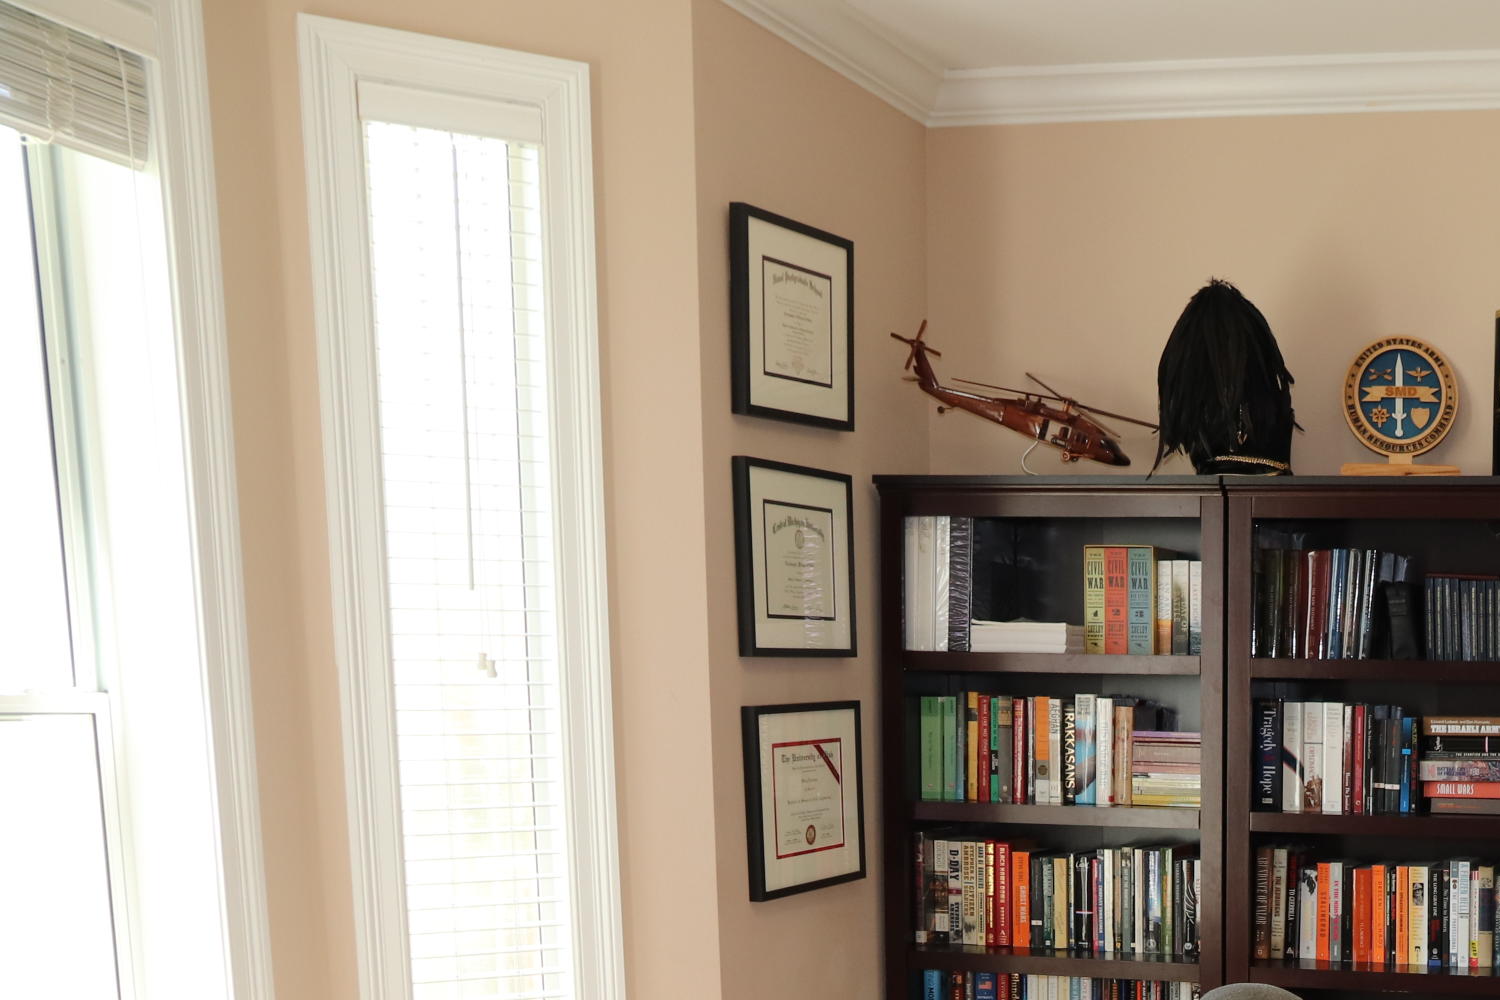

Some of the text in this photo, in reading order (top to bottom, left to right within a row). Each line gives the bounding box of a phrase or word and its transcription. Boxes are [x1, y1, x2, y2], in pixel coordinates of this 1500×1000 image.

[1355, 338, 1444, 367] UNITED STATES ARMY
[1347, 404, 1454, 452] HUMAN RESOURCES COMMAND
[1087, 561, 1104, 576] CIVIL
[1130, 561, 1148, 576] CIVIL
[1087, 577, 1104, 590] WAR
[1108, 576, 1124, 588] WAR
[1131, 578, 1148, 590] WAR
[1051, 704, 1059, 735] AFGHAN
[1259, 708, 1277, 751] Tragedy
[1431, 725, 1447, 733] THE
[1448, 725, 1480, 733] ISRAELI
[1064, 712, 1075, 789] RAKKASANS
[1259, 766, 1276, 794] Hope
[1436, 783, 1474, 795] SMALL WARS
[1274, 876, 1282, 886] THE
[1256, 856, 1268, 925] ABUNDANCE OF VALOR
